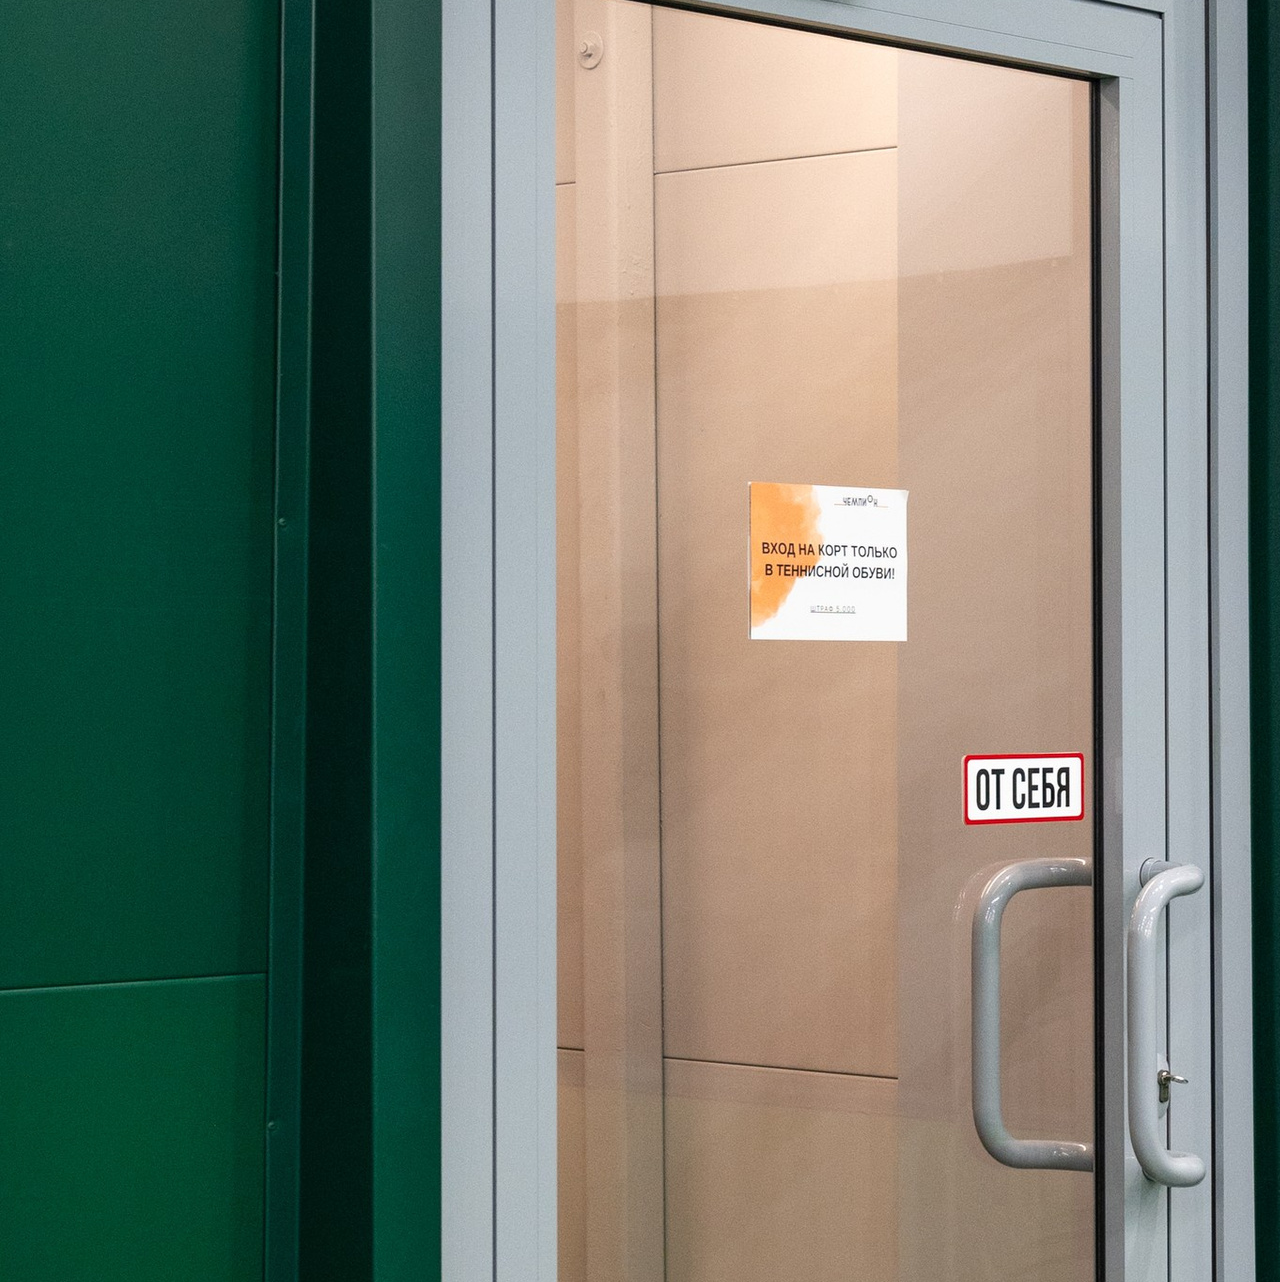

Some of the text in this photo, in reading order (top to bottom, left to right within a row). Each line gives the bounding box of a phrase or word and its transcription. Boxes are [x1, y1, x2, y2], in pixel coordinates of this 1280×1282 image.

[843, 495, 878, 507] ЧЕМПИОН
[762, 542, 897, 558] ВХОД НА КОРТ ТОЛЬКО
[765, 563, 895, 579] В ТЕННИСНОЙ ОБУВИ!
[810, 605, 833, 613] ШТРАФ
[976, 766, 1070, 811] ОТ СЕБЯ
